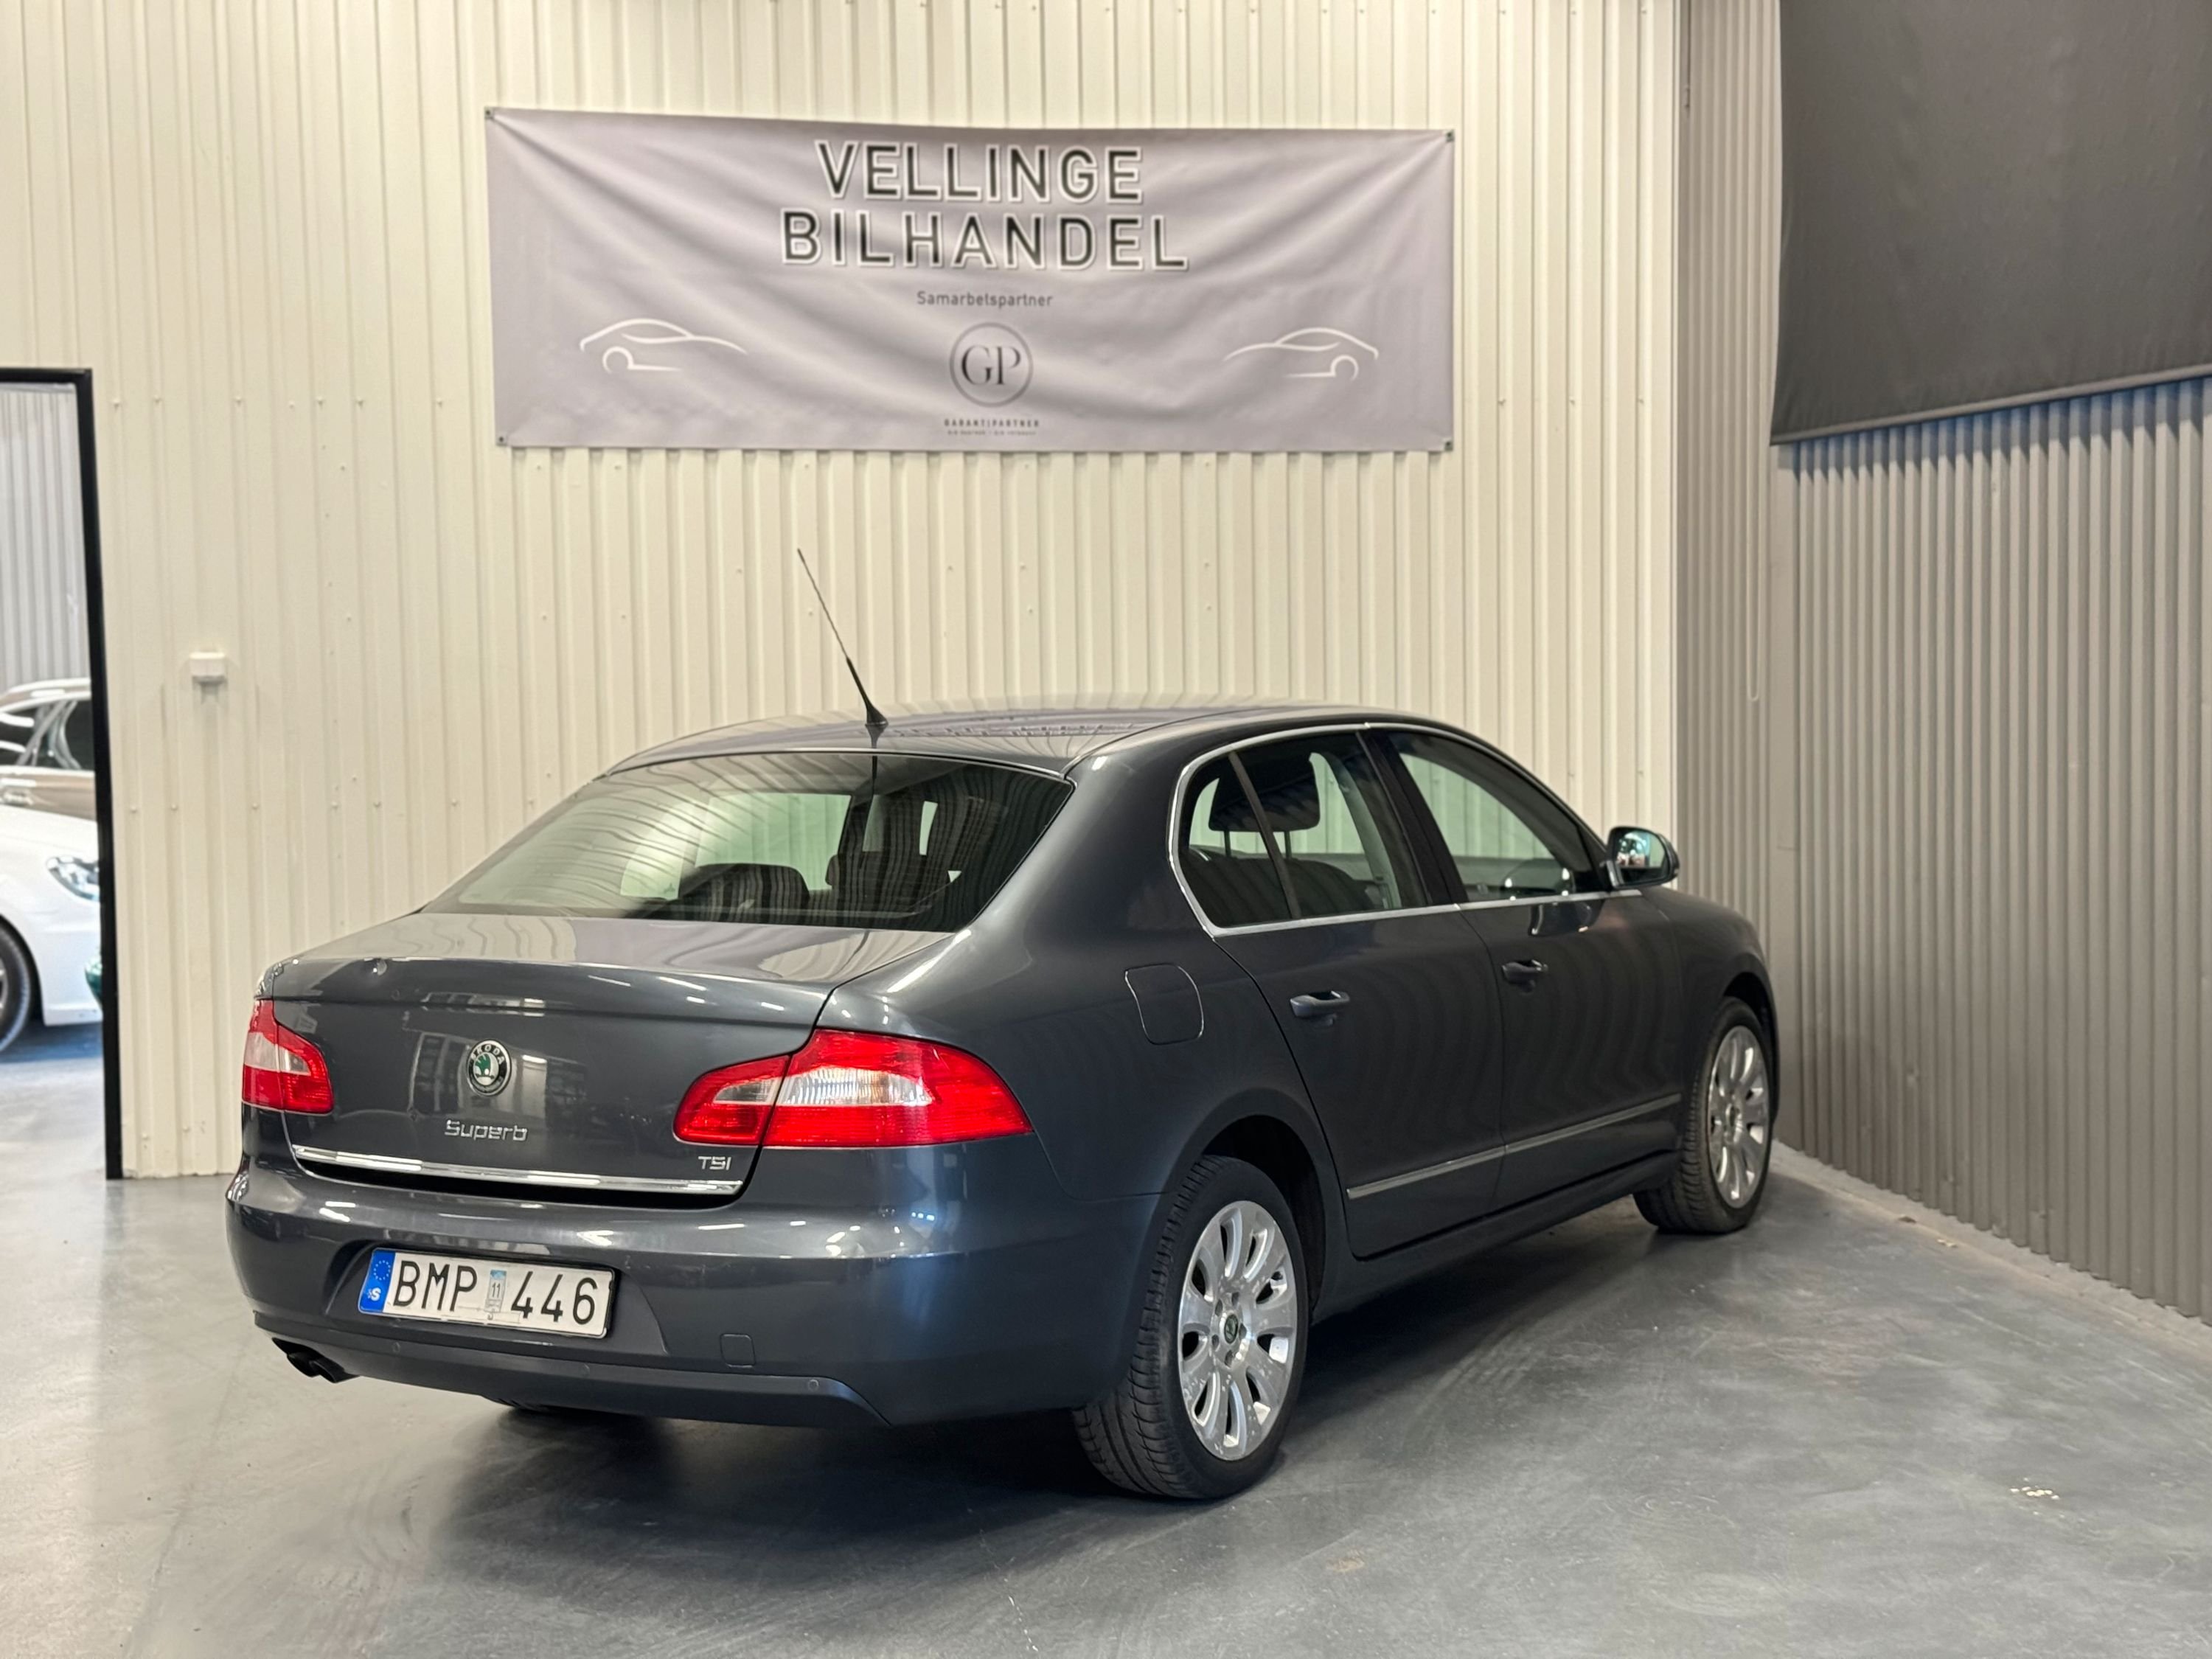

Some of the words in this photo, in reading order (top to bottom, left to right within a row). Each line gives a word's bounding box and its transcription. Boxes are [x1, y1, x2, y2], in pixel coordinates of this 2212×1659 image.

[815, 140, 1142, 204] VELLINGE
[780, 207, 1189, 271] BILHANDEL
[917, 291, 1054, 308] Samarbetspartner
[961, 344, 1021, 386] GP
[445, 1119, 528, 1141] Superb
[698, 1155, 732, 1171] TSI
[370, 1287, 382, 1301] S
[393, 1260, 478, 1312] BMP
[510, 1270, 598, 1325] 446
